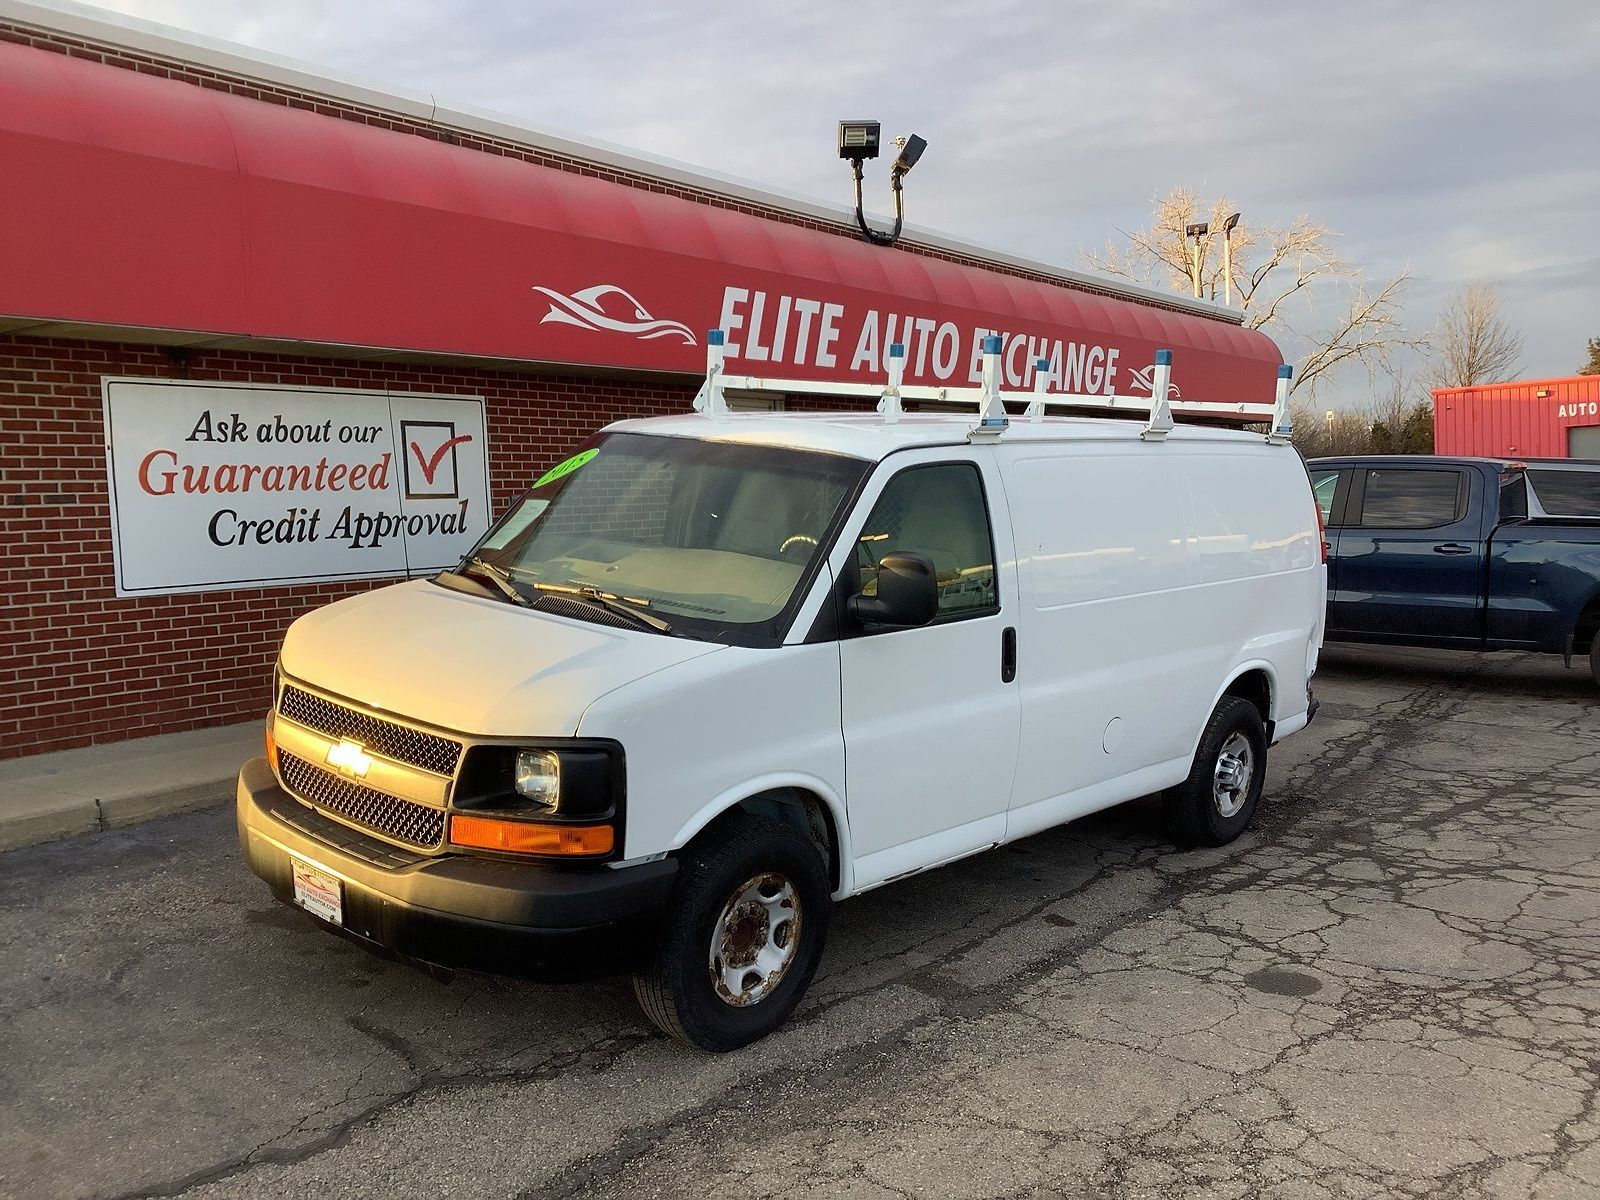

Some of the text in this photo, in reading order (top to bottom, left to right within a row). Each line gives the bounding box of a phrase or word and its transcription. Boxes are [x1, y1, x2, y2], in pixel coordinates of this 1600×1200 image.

[718, 286, 845, 368] ELITE
[849, 309, 960, 380] AUTO
[185, 409, 383, 444] Ask about our
[1559, 402, 1597, 417] AUTO
[137, 449, 392, 496] Guaranteed
[207, 499, 470, 550] Credit Approval
